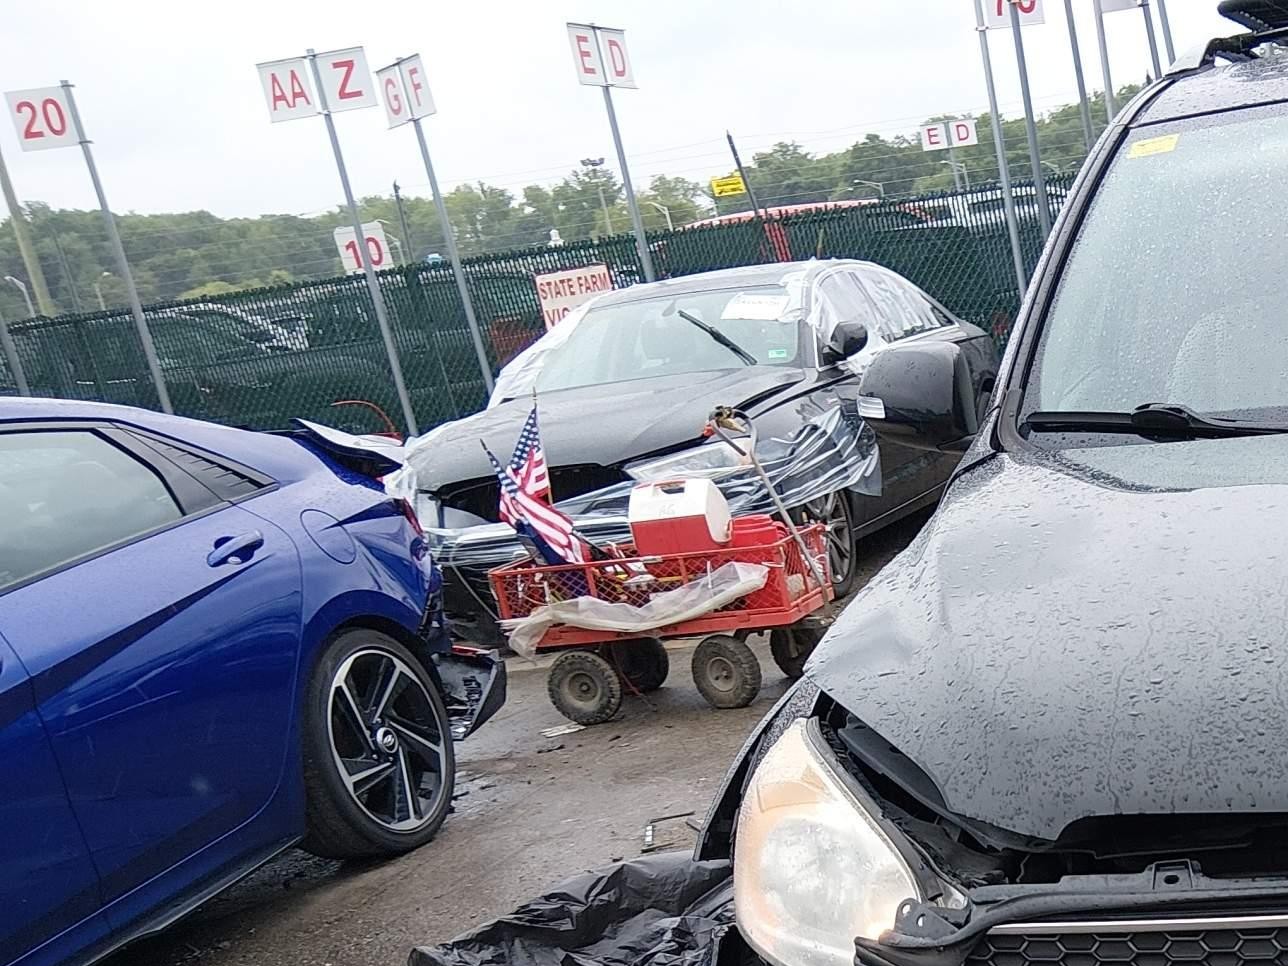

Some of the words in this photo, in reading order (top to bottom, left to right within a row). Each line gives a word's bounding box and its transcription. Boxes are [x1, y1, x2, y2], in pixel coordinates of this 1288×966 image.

[576, 35, 596, 74] E
[608, 39, 626, 77] D
[271, 69, 311, 111] AA
[332, 59, 363, 100] Z
[385, 78, 402, 115] G
[408, 67, 422, 107] F
[16, 98, 67, 140] 20
[927, 127, 941, 145] E
[955, 123, 969, 141] D
[345, 236, 383, 269] 10
[539, 278, 576, 300] STATE
[577, 272, 609, 294] FARM
